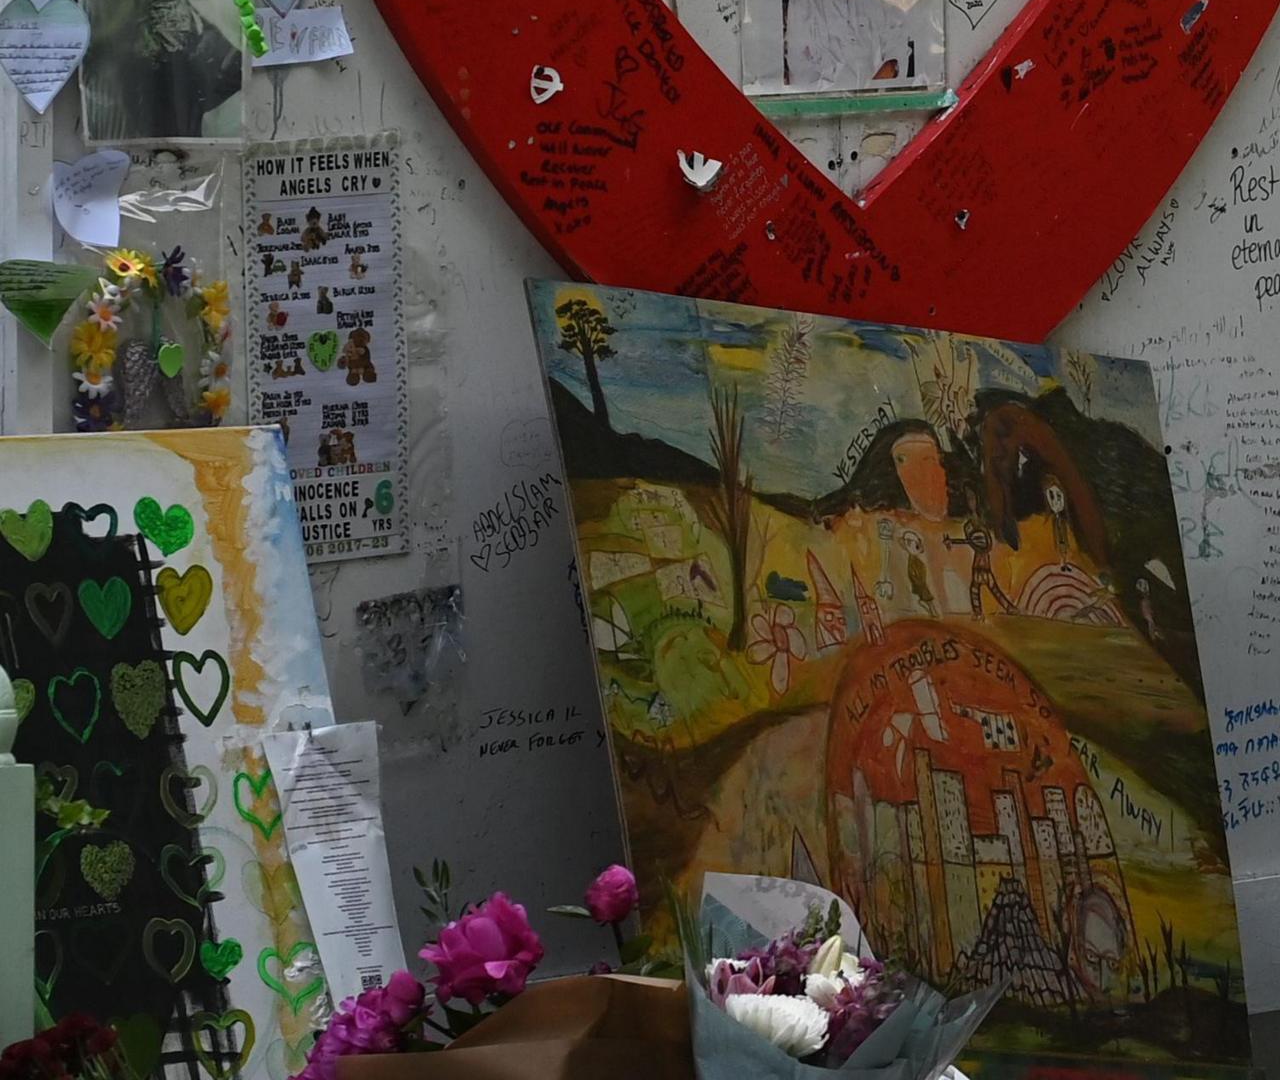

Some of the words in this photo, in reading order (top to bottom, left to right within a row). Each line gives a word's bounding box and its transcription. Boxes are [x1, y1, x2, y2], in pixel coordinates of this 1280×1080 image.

[257, 159, 286, 176] HOW
[290, 157, 304, 172] IT
[309, 153, 349, 173] FEELS
[353, 151, 390, 169] WHEN
[279, 177, 332, 197] ANGELS
[341, 174, 368, 192] CRY
[1230, 165, 1280, 205] Rest
[1243, 213, 1263, 234] in
[832, 399, 899, 486] YESTERDAY
[339, 501, 357, 518] ON
[374, 479, 394, 515] 6
[372, 518, 392, 532] YRS
[480, 707, 555, 729] JESSICA
[479, 738, 519, 758] NEVER
[528, 731, 585, 752] FORGET
[846, 694, 870, 725] ALL
[869, 665, 890, 698] MY
[888, 638, 961, 678] TROUBLES
[971, 649, 1018, 689] SEEM
[1067, 735, 1101, 780] FAR
[1109, 777, 1165, 842] AWAY
